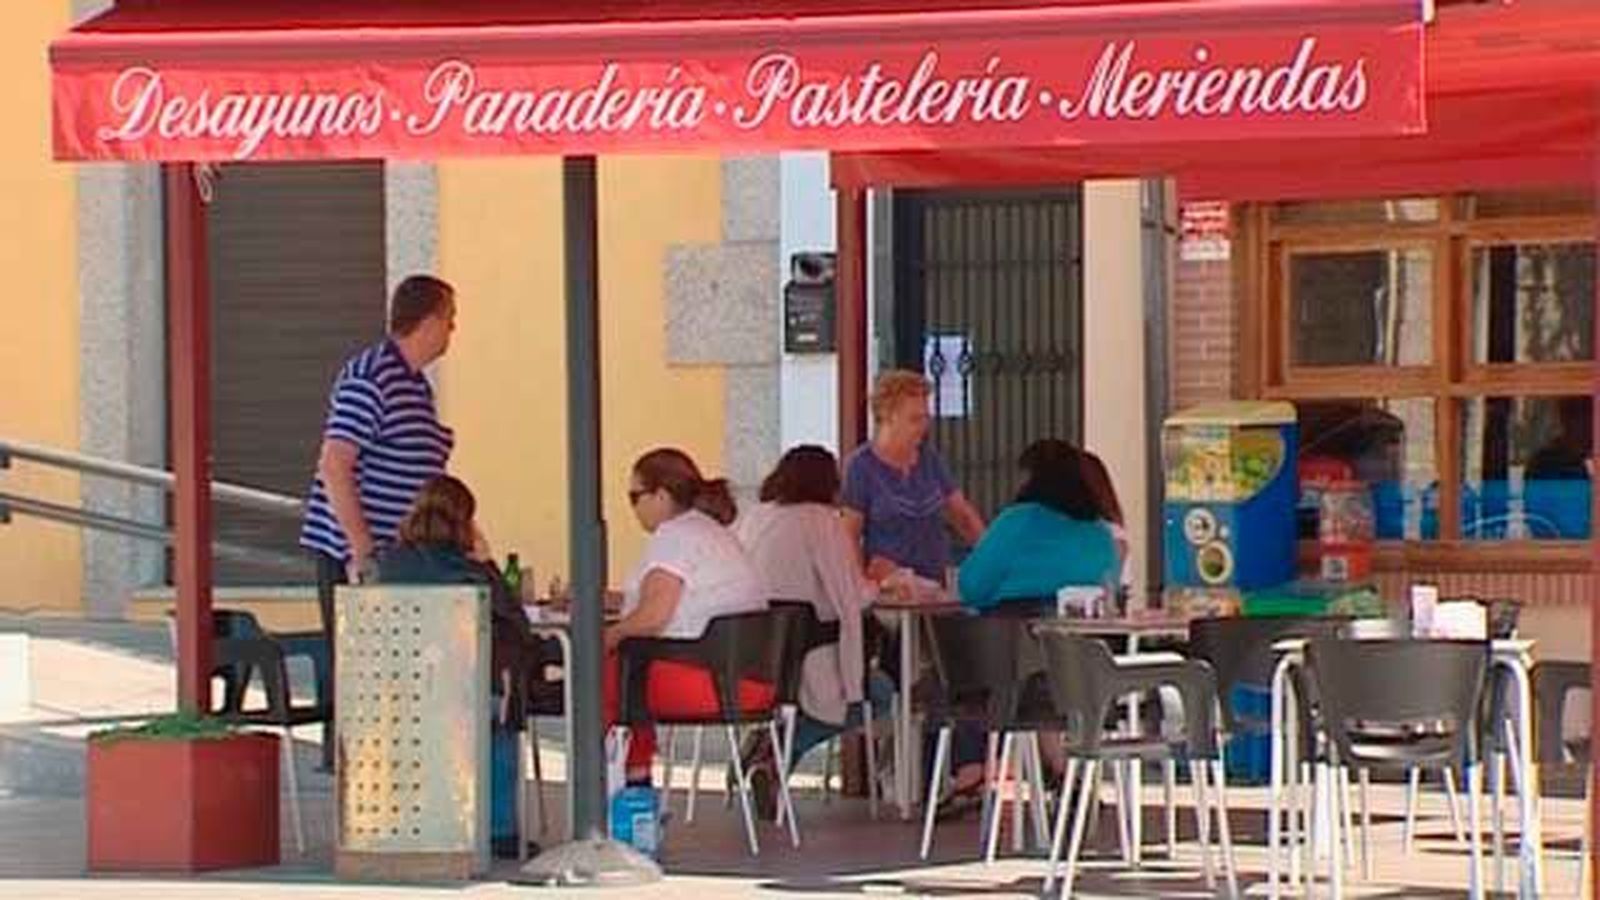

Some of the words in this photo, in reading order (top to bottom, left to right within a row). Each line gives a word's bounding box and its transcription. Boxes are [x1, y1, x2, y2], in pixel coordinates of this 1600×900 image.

[100, 66, 383, 158] Desayunos
[407, 60, 704, 135] Panadería
[734, 52, 1028, 127] Pastelería
[1060, 38, 1367, 119] Meriendas
